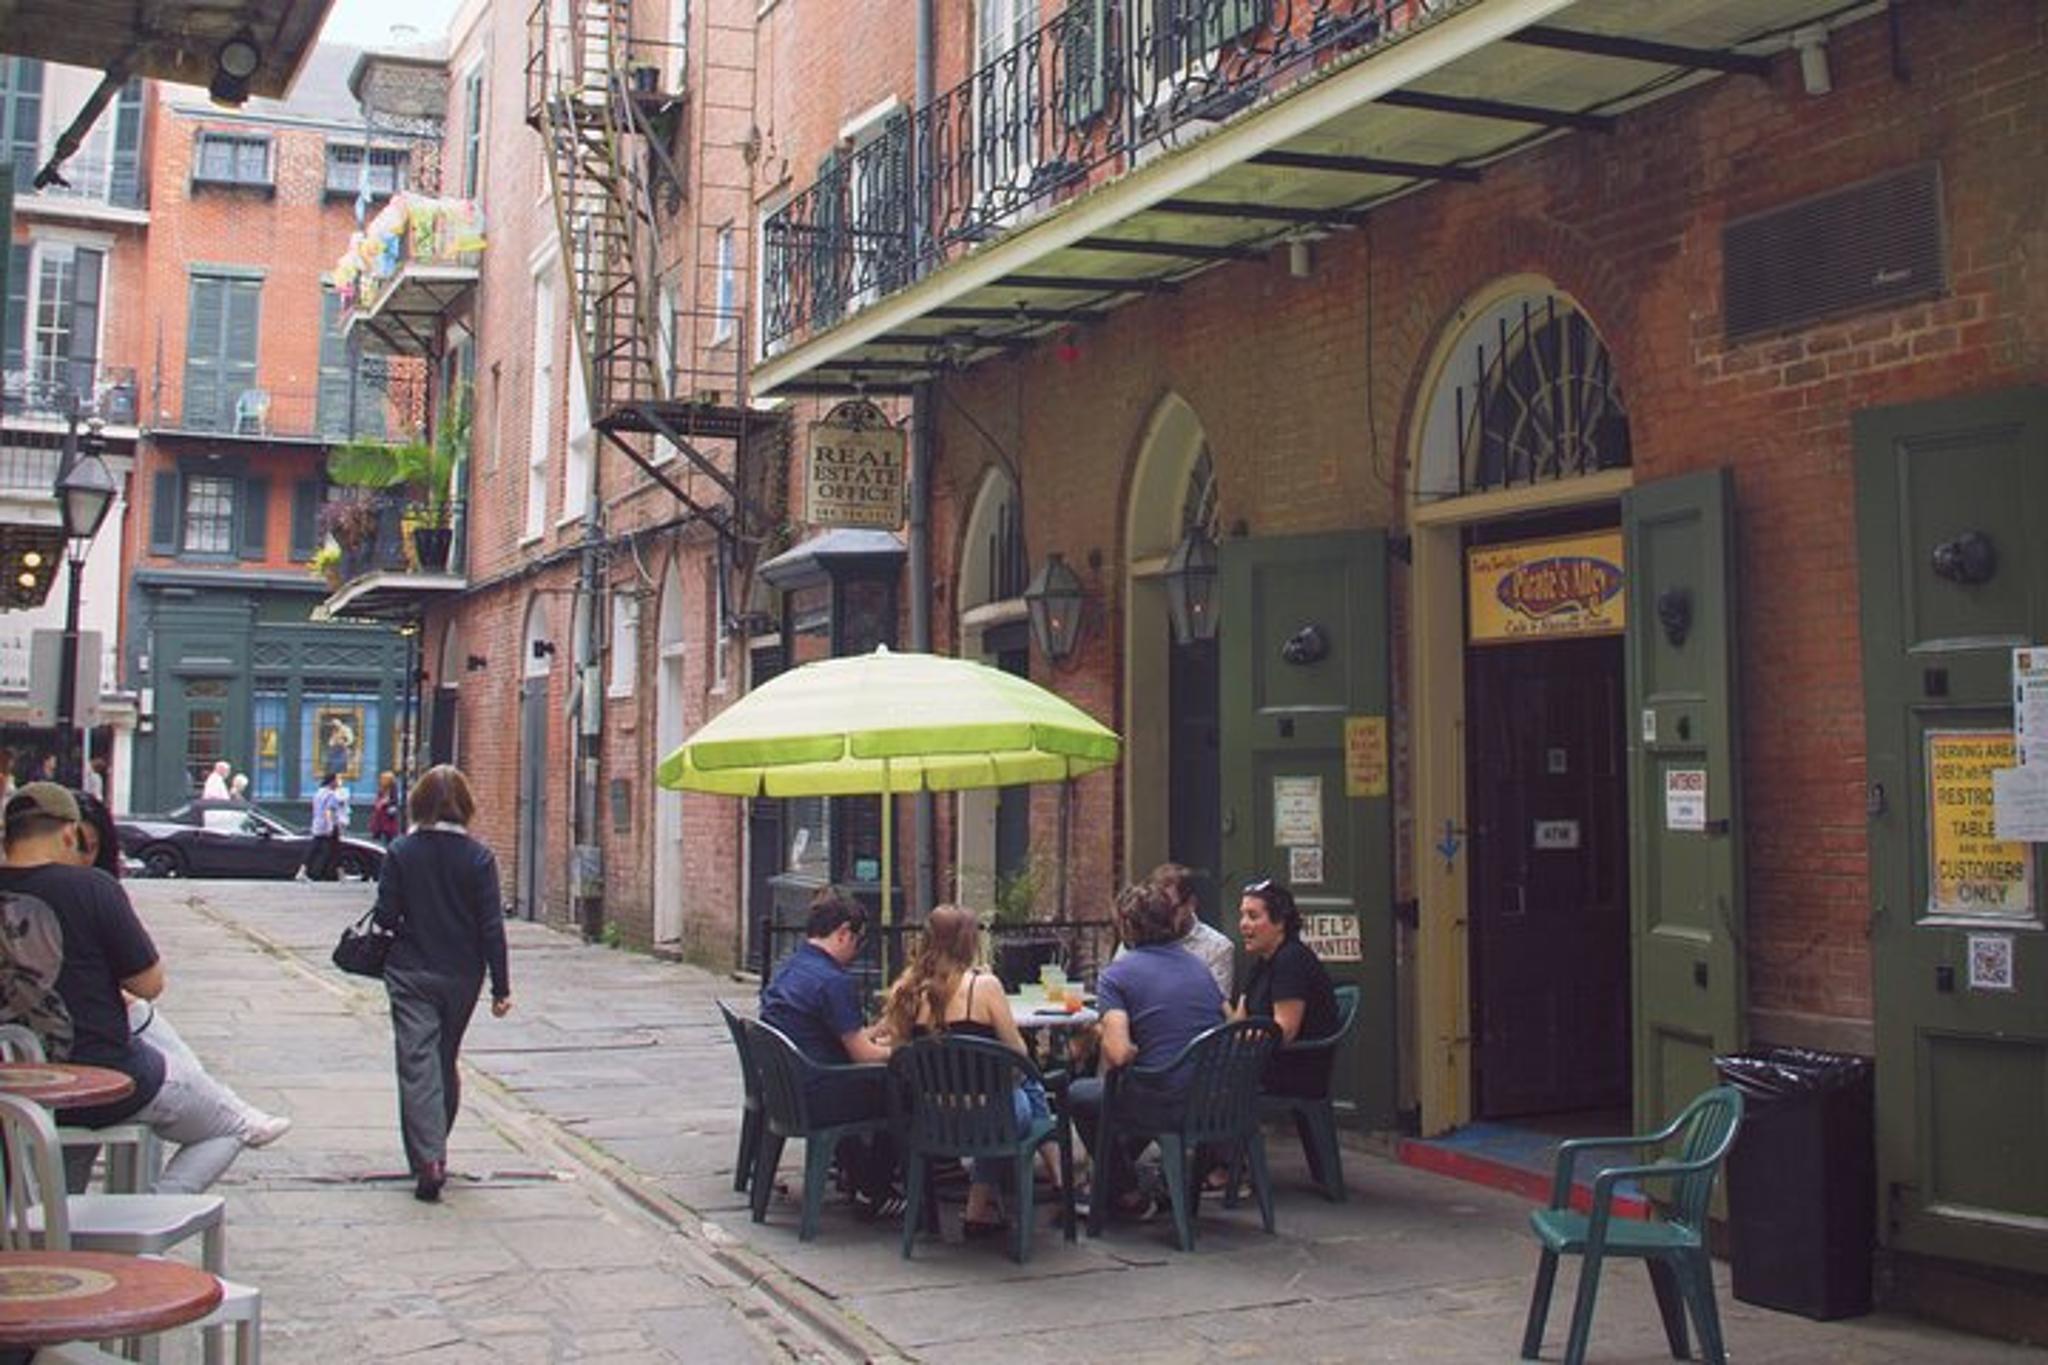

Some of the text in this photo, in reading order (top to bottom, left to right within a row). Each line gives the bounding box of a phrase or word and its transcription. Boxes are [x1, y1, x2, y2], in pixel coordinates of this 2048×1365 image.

[815, 446, 900, 467] REAL
[814, 465, 900, 487] ESTATE
[818, 483, 896, 502] OFFICE
[1936, 744, 1983, 758] SERVING
[1937, 787, 1995, 806] RESTRO
[1959, 844, 2003, 854] ARE FOR
[1939, 859, 2024, 882] CUSTOMERS
[1958, 883, 2009, 905] ONLY
[1304, 917, 1354, 937] HELP
